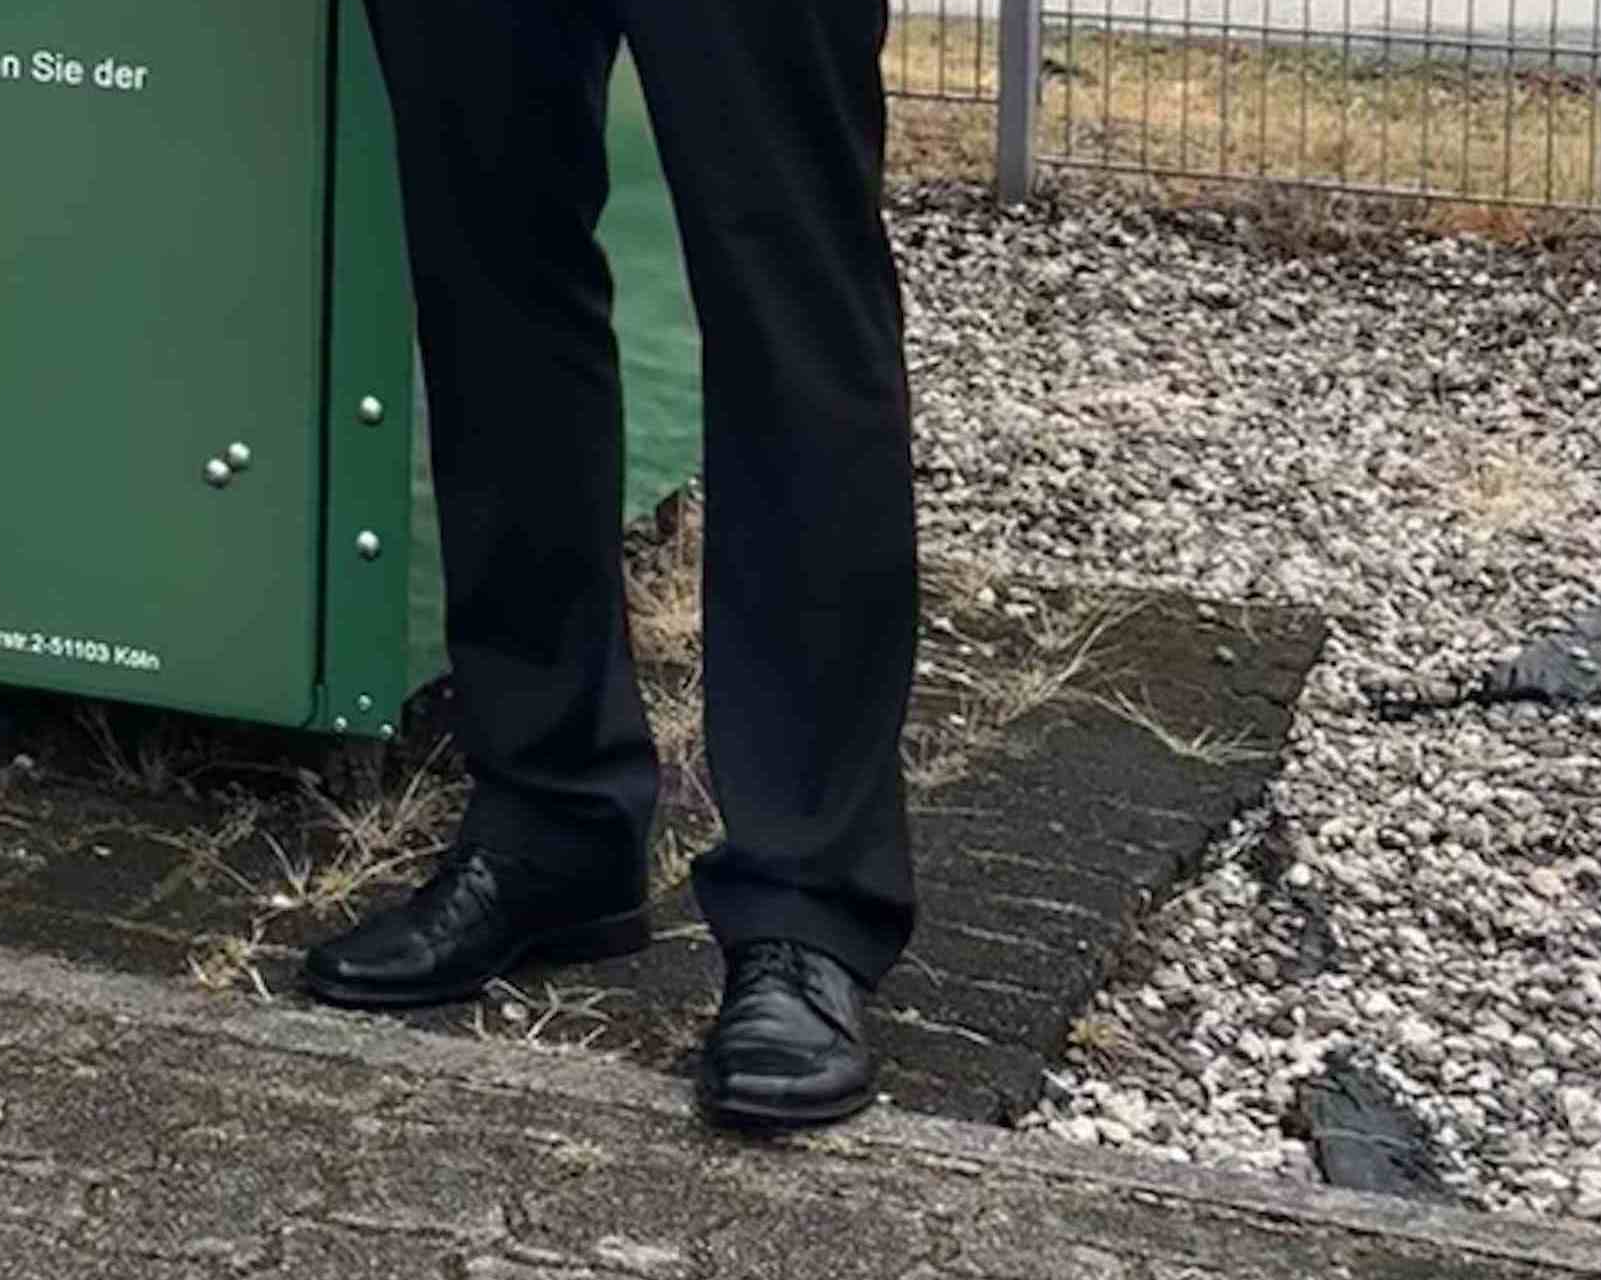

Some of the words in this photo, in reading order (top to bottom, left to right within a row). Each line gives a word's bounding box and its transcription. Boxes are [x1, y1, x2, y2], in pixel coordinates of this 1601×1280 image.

[31, 50, 84, 86] Sie
[94, 57, 149, 91] der
[113, 644, 161, 671] Köln
